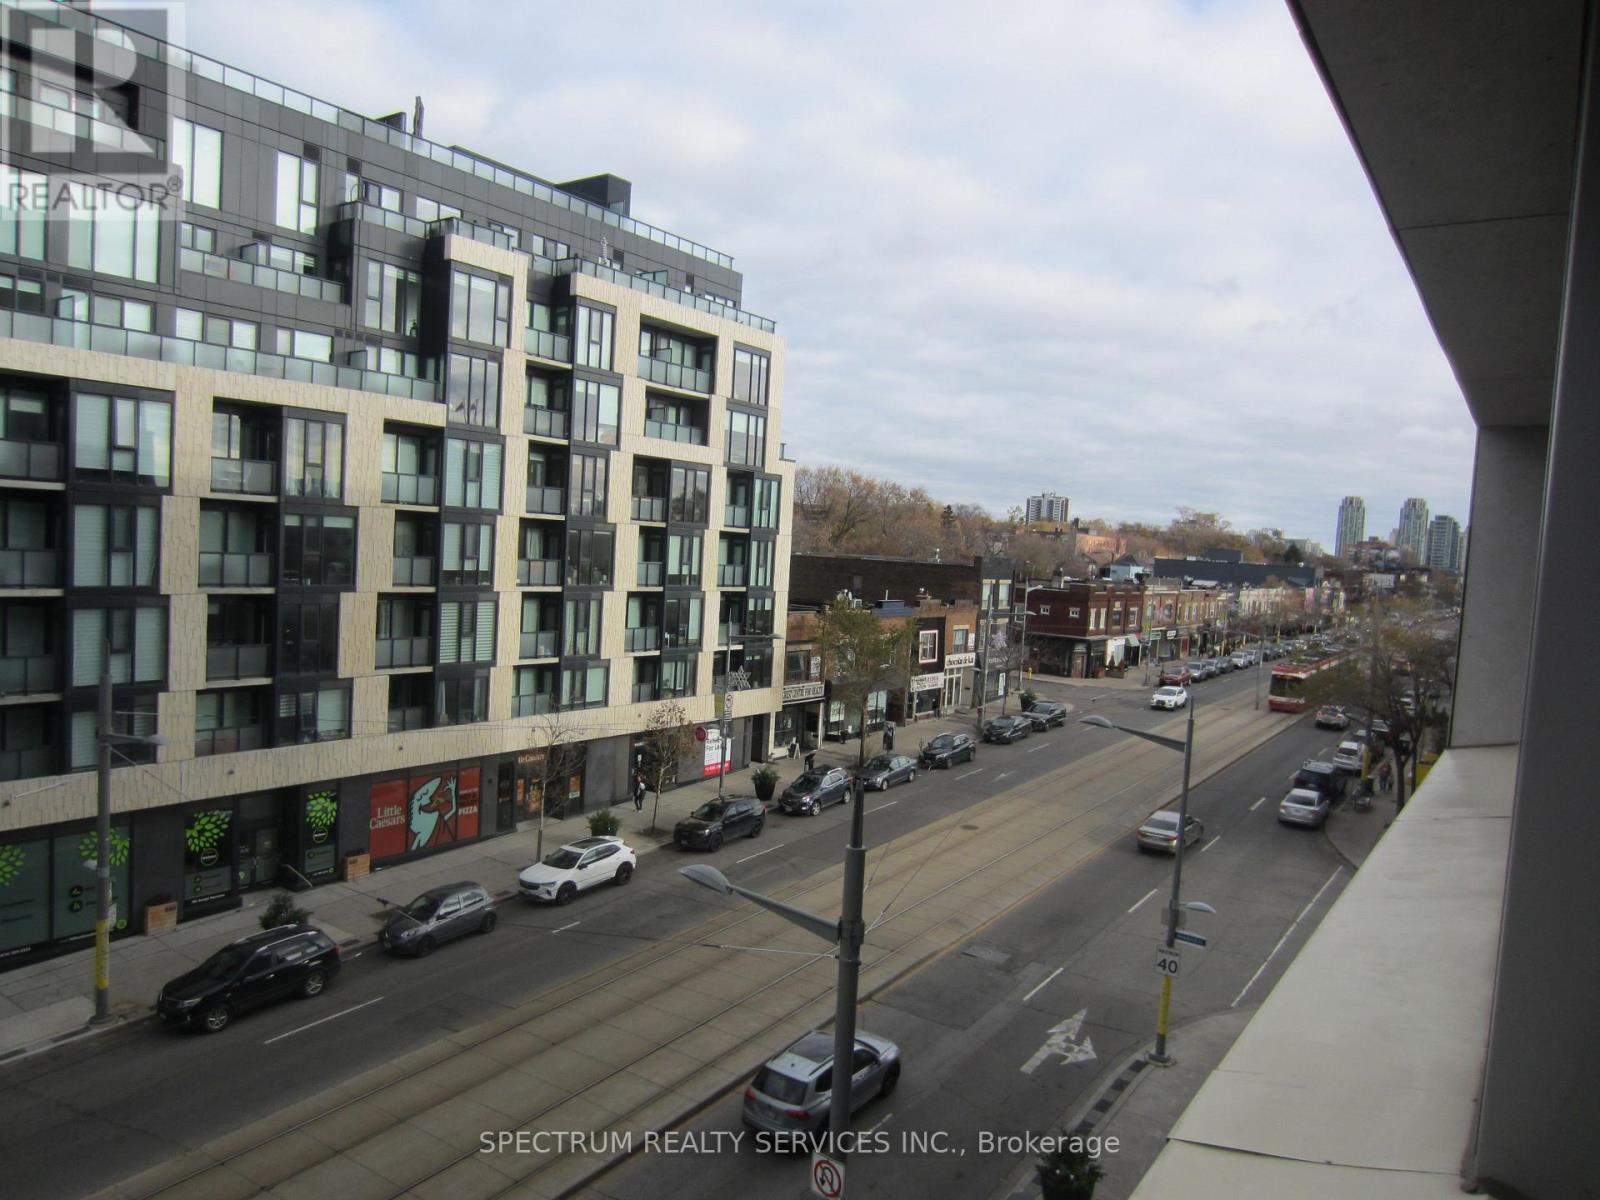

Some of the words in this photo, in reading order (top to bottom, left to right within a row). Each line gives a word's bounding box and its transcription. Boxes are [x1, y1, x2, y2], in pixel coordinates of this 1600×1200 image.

[378, 805, 402, 818] Little
[458, 805, 479, 815] PIZZA
[370, 815, 406, 829] Caesars
[1158, 958, 1178, 974] 40
